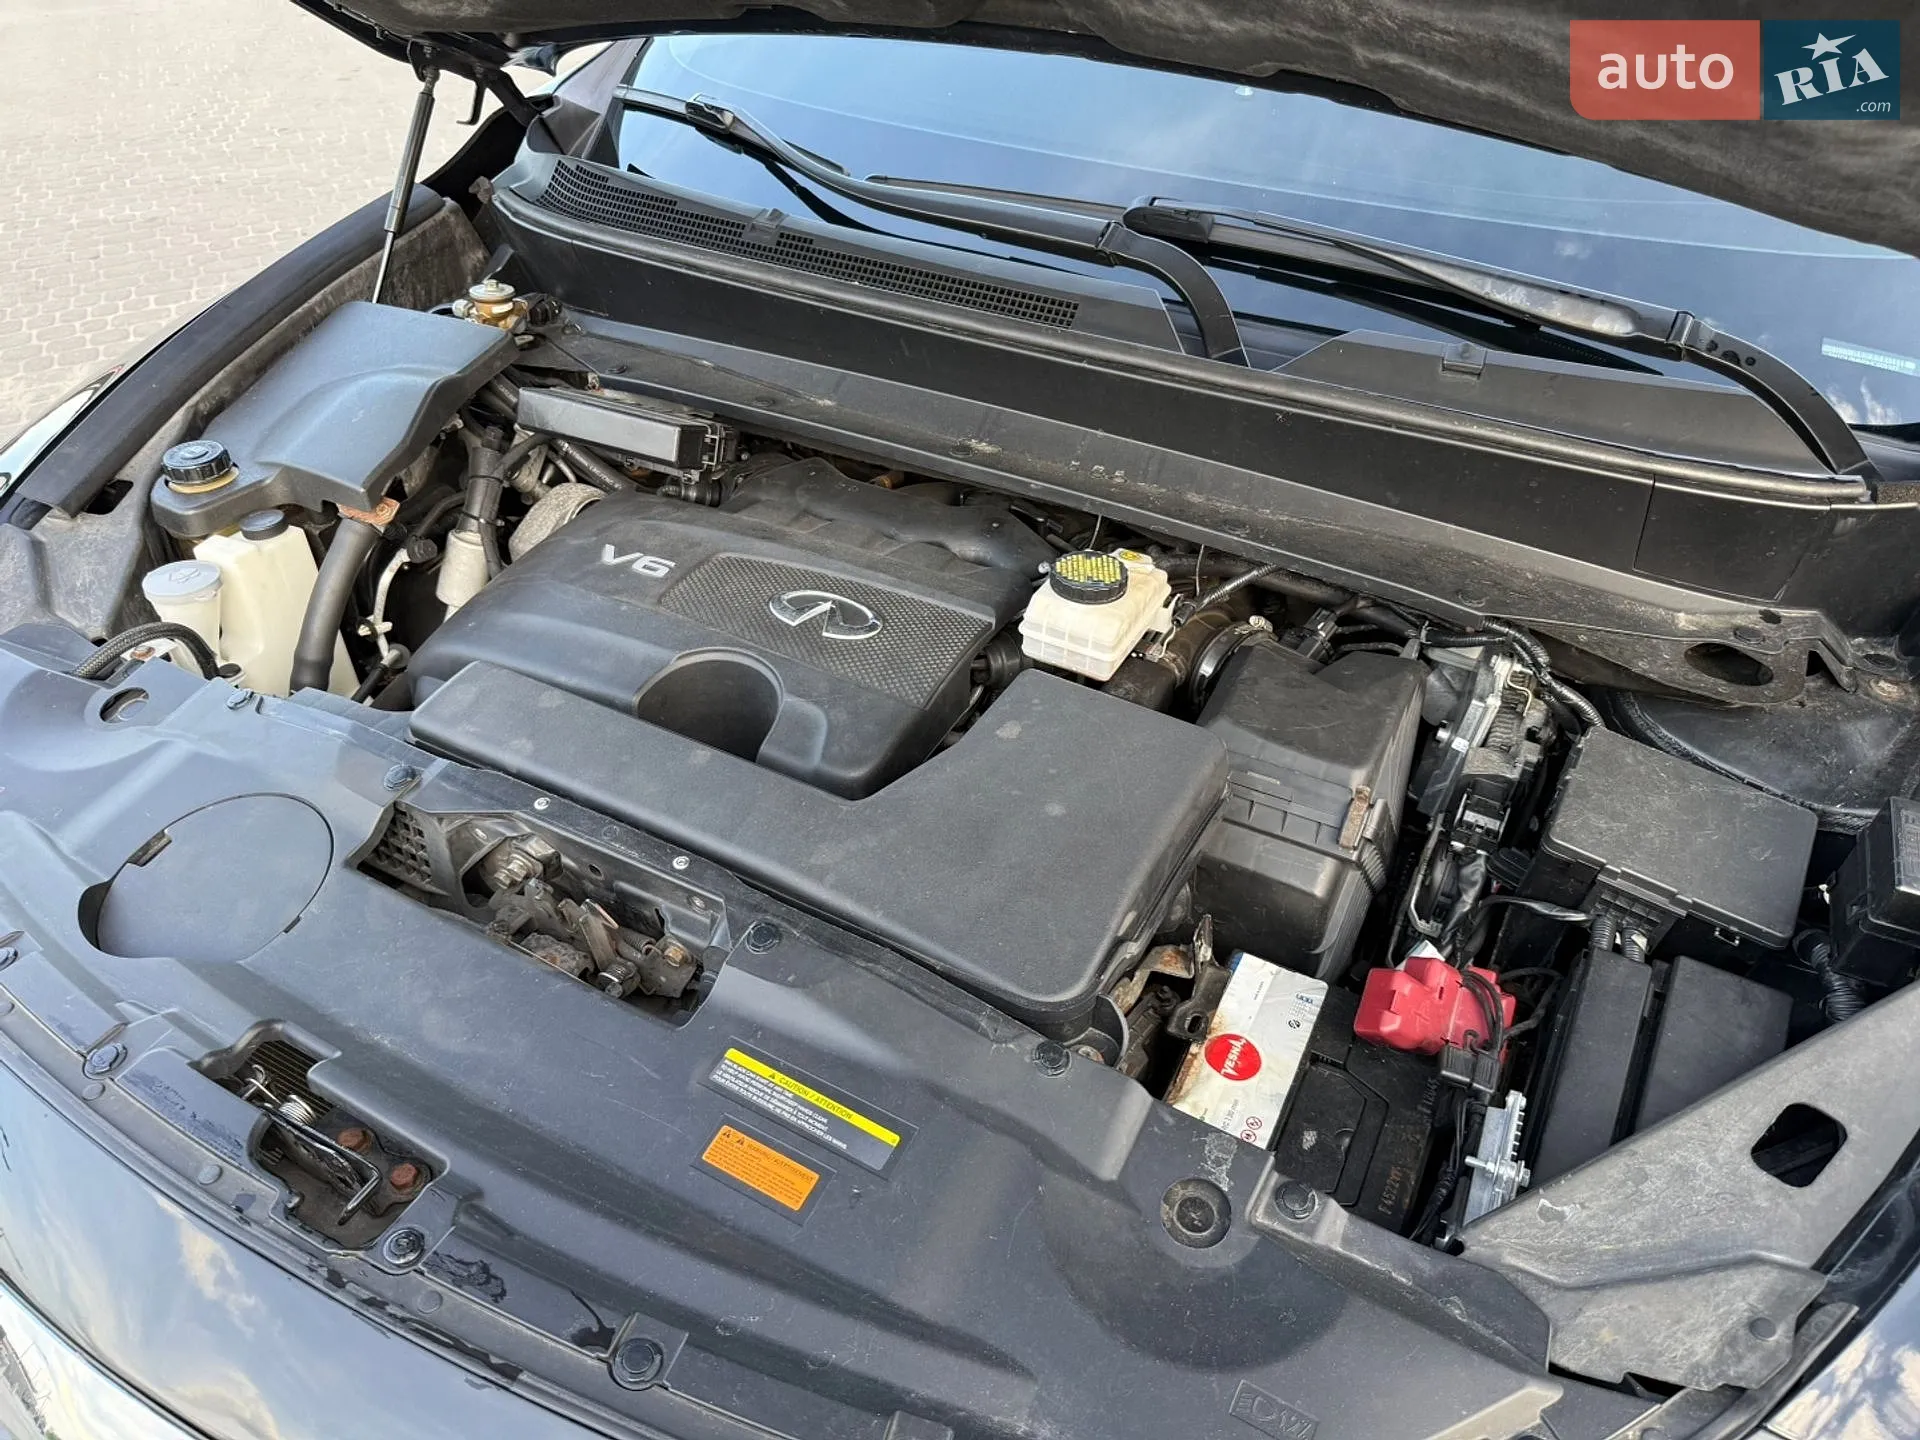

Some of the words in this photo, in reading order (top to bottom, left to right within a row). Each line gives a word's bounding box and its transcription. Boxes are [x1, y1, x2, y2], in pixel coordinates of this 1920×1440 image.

[602, 543, 676, 578] V6
[1220, 1038, 1247, 1077] VESNA
[778, 1076, 810, 1098] CAUTION
[815, 1093, 854, 1120] ATTENTION
